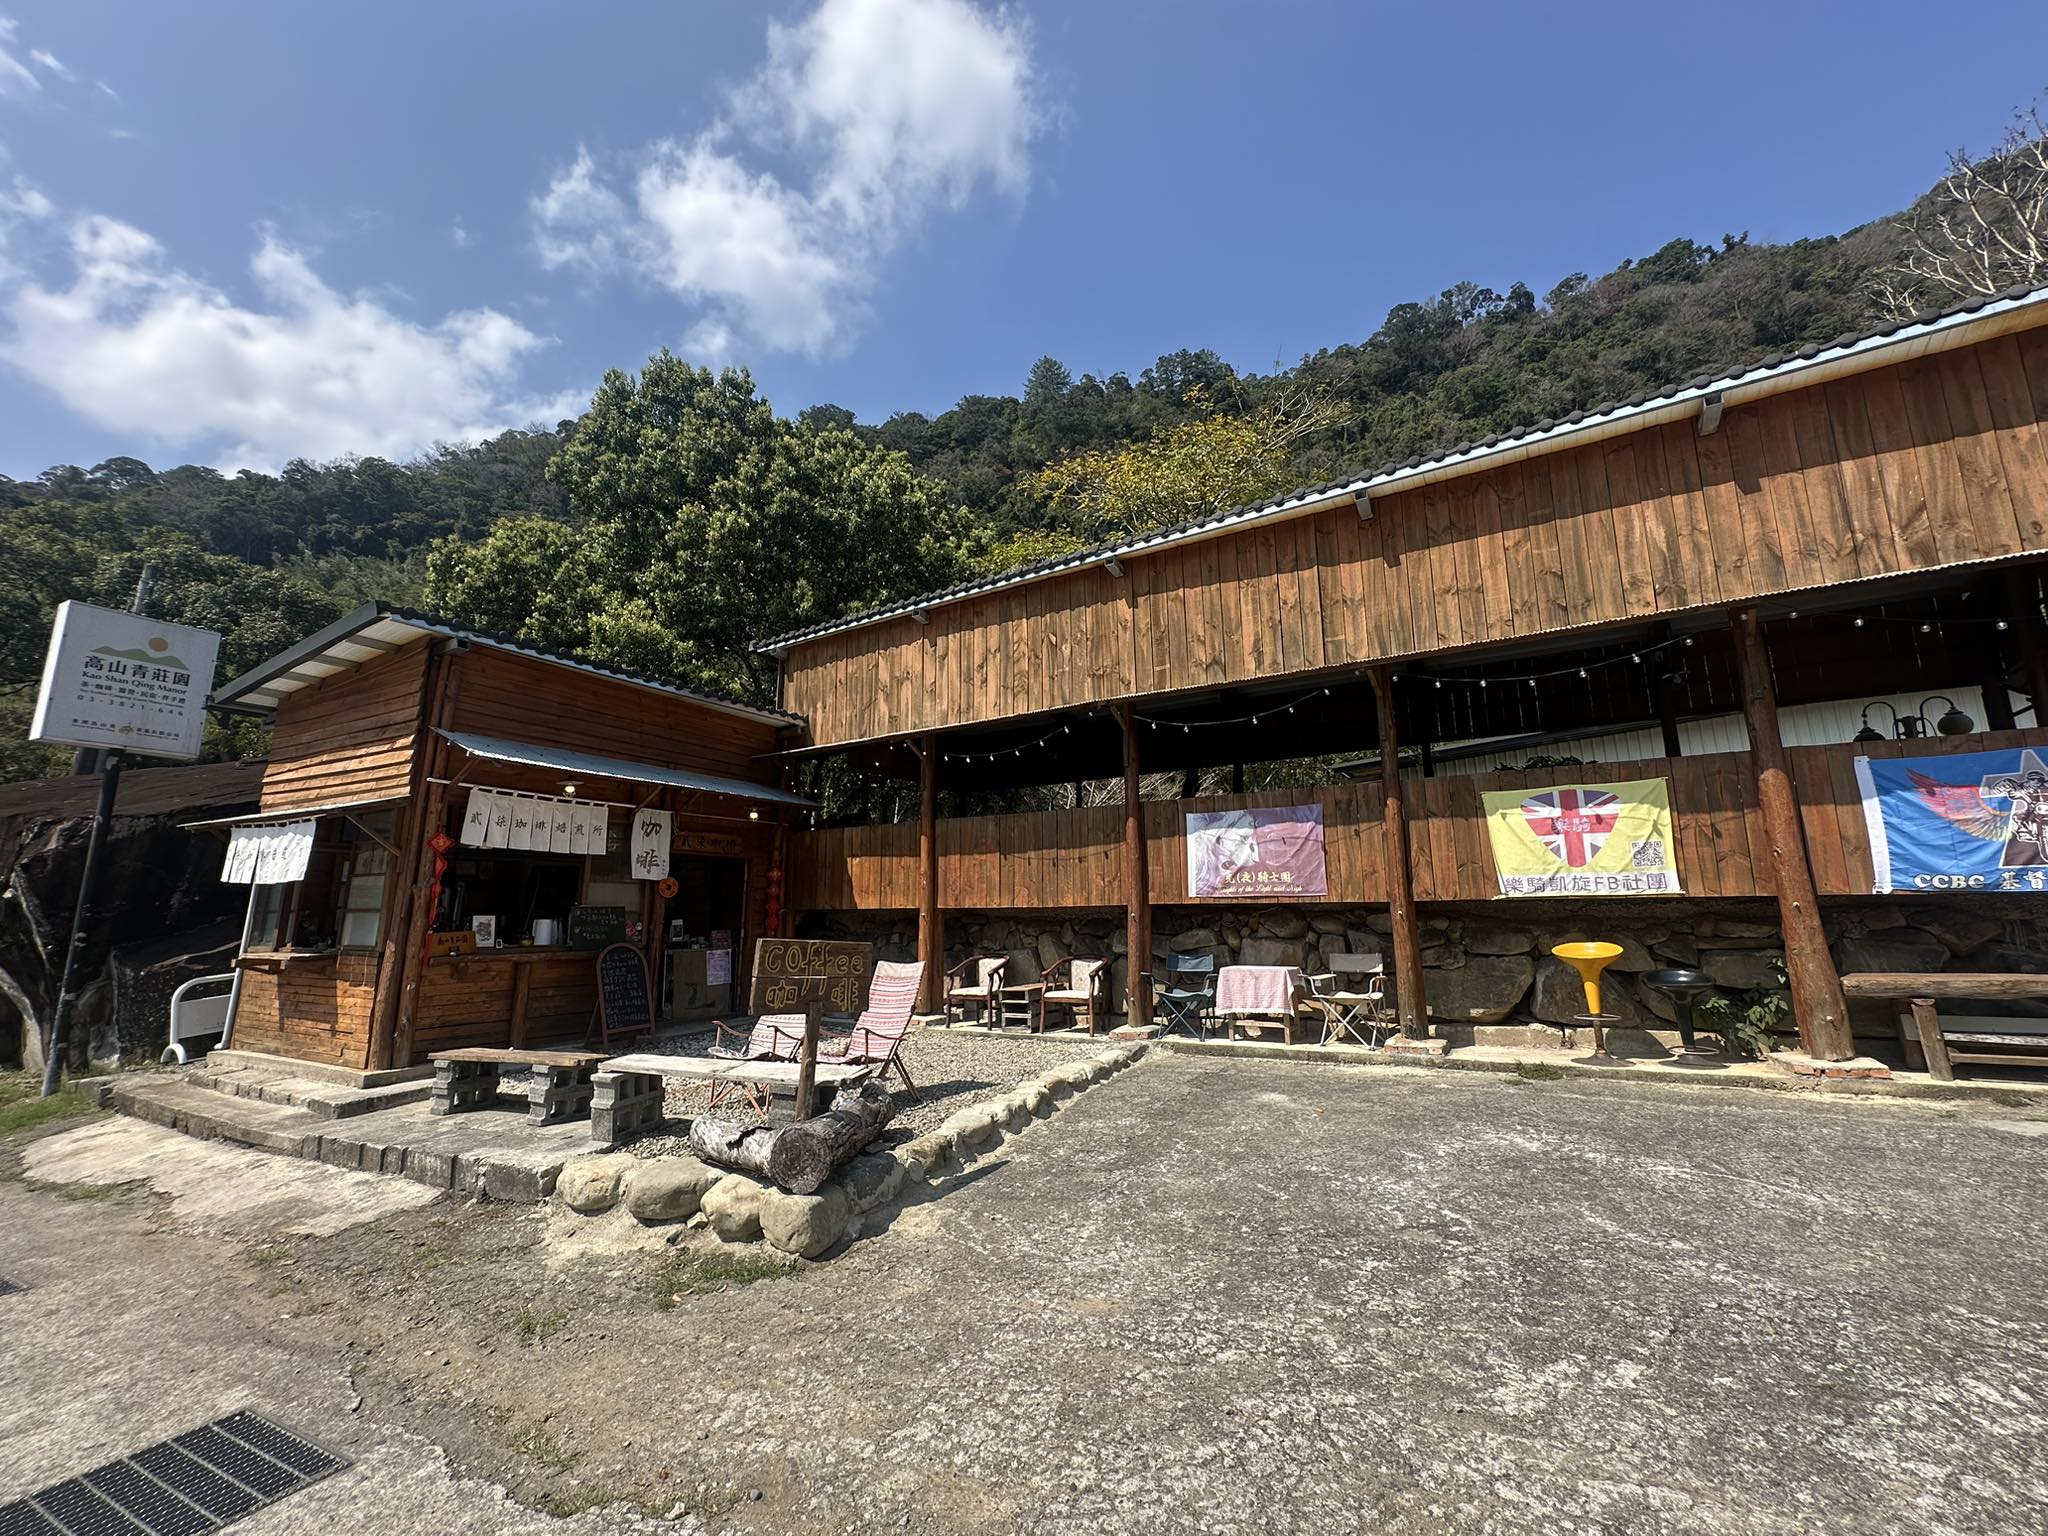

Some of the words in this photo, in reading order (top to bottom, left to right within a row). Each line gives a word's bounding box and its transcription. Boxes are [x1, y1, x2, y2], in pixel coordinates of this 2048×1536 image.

[82, 671, 102, 680] Kao
[105, 675, 129, 685] Shan
[131, 679, 155, 691] Qing
[157, 684, 188, 695] Manor
[84, 656, 191, 687] 高山青莊園
[1914, 873, 1985, 889] CCBC
